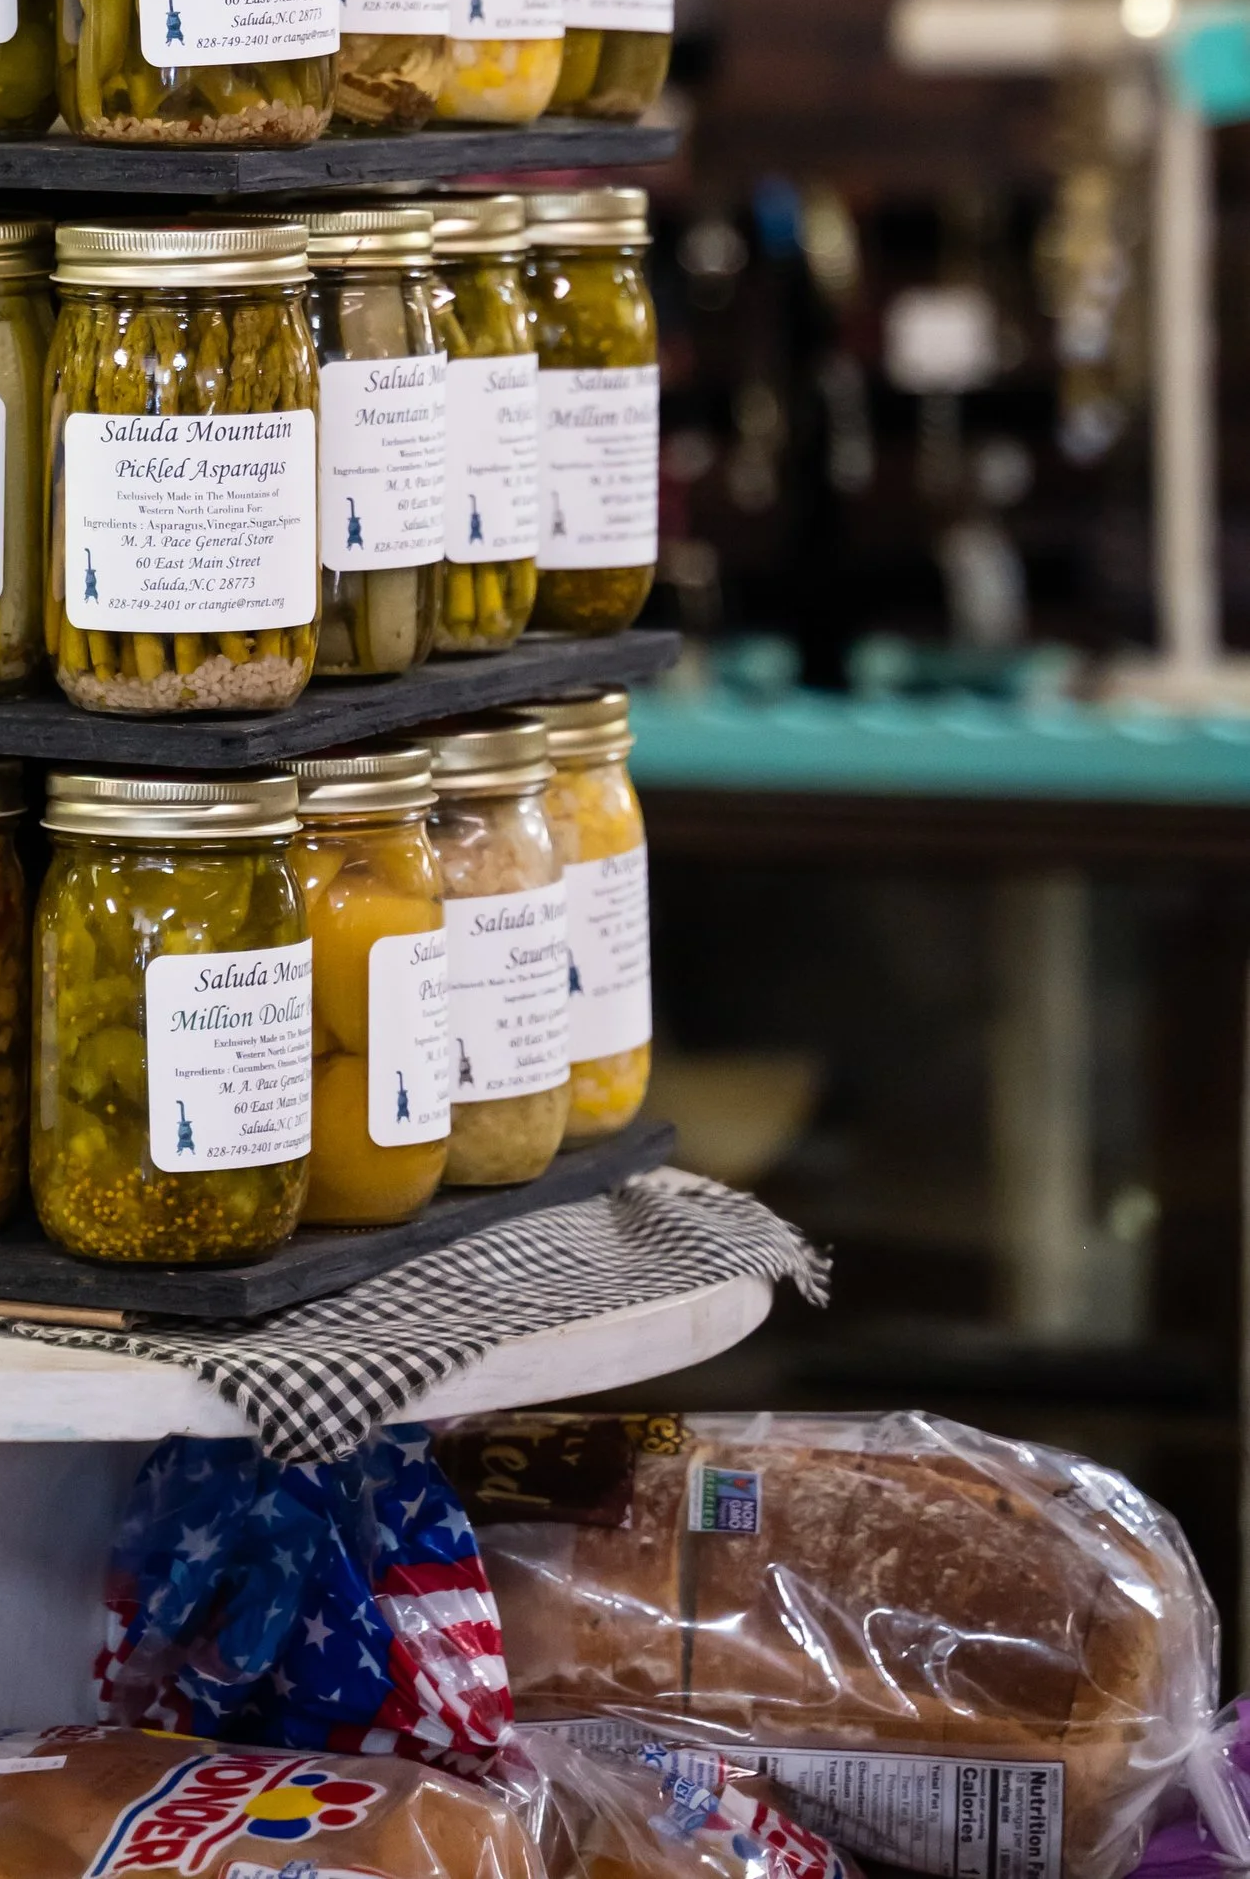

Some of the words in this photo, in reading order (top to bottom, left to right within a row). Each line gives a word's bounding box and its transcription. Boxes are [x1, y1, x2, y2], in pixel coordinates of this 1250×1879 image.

[364, 366, 425, 394] Saluda
[355, 407, 430, 427] Mountain
[100, 417, 179, 442] Saluda
[186, 416, 293, 443] Mountain
[115, 457, 191, 483] Pickled
[190, 459, 287, 484] Asparagus
[116, 491, 164, 502] Exclusively
[167, 492, 192, 501] Made
[206, 491, 223, 501] The
[226, 490, 270, 500] Mountains
[138, 505, 174, 515] Western
[178, 505, 204, 514] North
[207, 505, 243, 514] Carolina
[83, 517, 136, 530] Ingredients
[161, 535, 190, 548] Pace
[195, 532, 243, 551] General
[244, 533, 274, 547] Store
[136, 556, 151, 569] 60
[154, 557, 184, 569] East
[188, 556, 223, 569] Main
[226, 556, 261, 569] Street
[219, 577, 255, 590] 28773
[108, 598, 180, 611] 828-749-2401
[184, 600, 196, 610] or
[198, 596, 284, 613] ctangie@rsnet.org
[470, 903, 535, 937] Saluda
[194, 961, 267, 993] Saluda
[170, 1005, 253, 1032] Million
[259, 997, 305, 1026] Dollar
[214, 1035, 257, 1049] Exclusively
[260, 1035, 277, 1044] Made
[236, 1050, 265, 1060] Western
[175, 1068, 225, 1079] Ingredients
[256, 1078, 277, 1091] Pace
[234, 1102, 248, 1115] 60
[250, 1100, 273, 1113] East
[207, 1142, 271, 1158] 828-749-2401
[729, 1500, 742, 1529] GMO
[741, 1501, 755, 1529] NON
[961, 1767, 978, 1843] Calories
[1028, 1771, 1048, 1858] Nutrition
